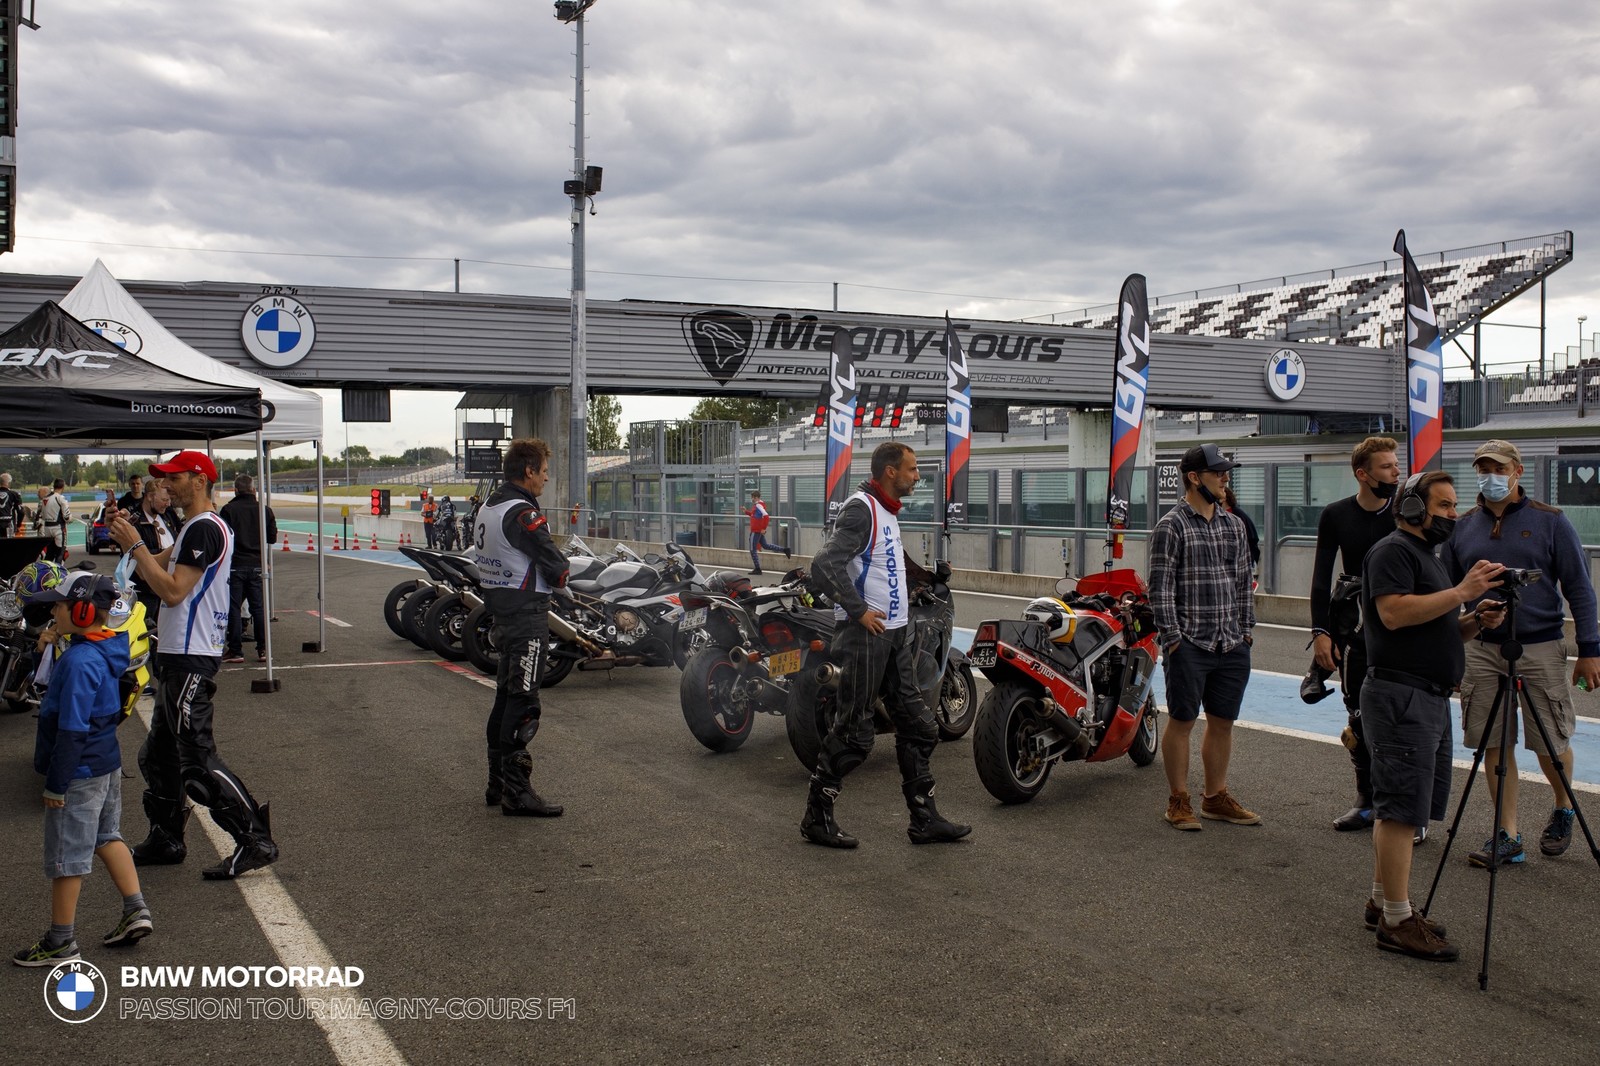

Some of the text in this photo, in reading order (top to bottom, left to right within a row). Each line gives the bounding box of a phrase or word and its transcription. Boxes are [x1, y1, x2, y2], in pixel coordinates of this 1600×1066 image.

[251, 298, 306, 318] BMW
[95, 321, 131, 335] MW
[0, 348, 119, 369] BMC
[1115, 301, 1149, 428] BMC
[1273, 351, 1301, 365] BMW
[757, 365, 885, 378] INTERNANAL
[969, 373, 1006, 383] EVERS
[1009, 375, 1055, 384] FRANCE
[131, 401, 237, 415] bmc-moto.com
[829, 352, 856, 446] BMC
[883, 525, 900, 621] TRACKDAYS
[183, 673, 202, 731] DAINESE
